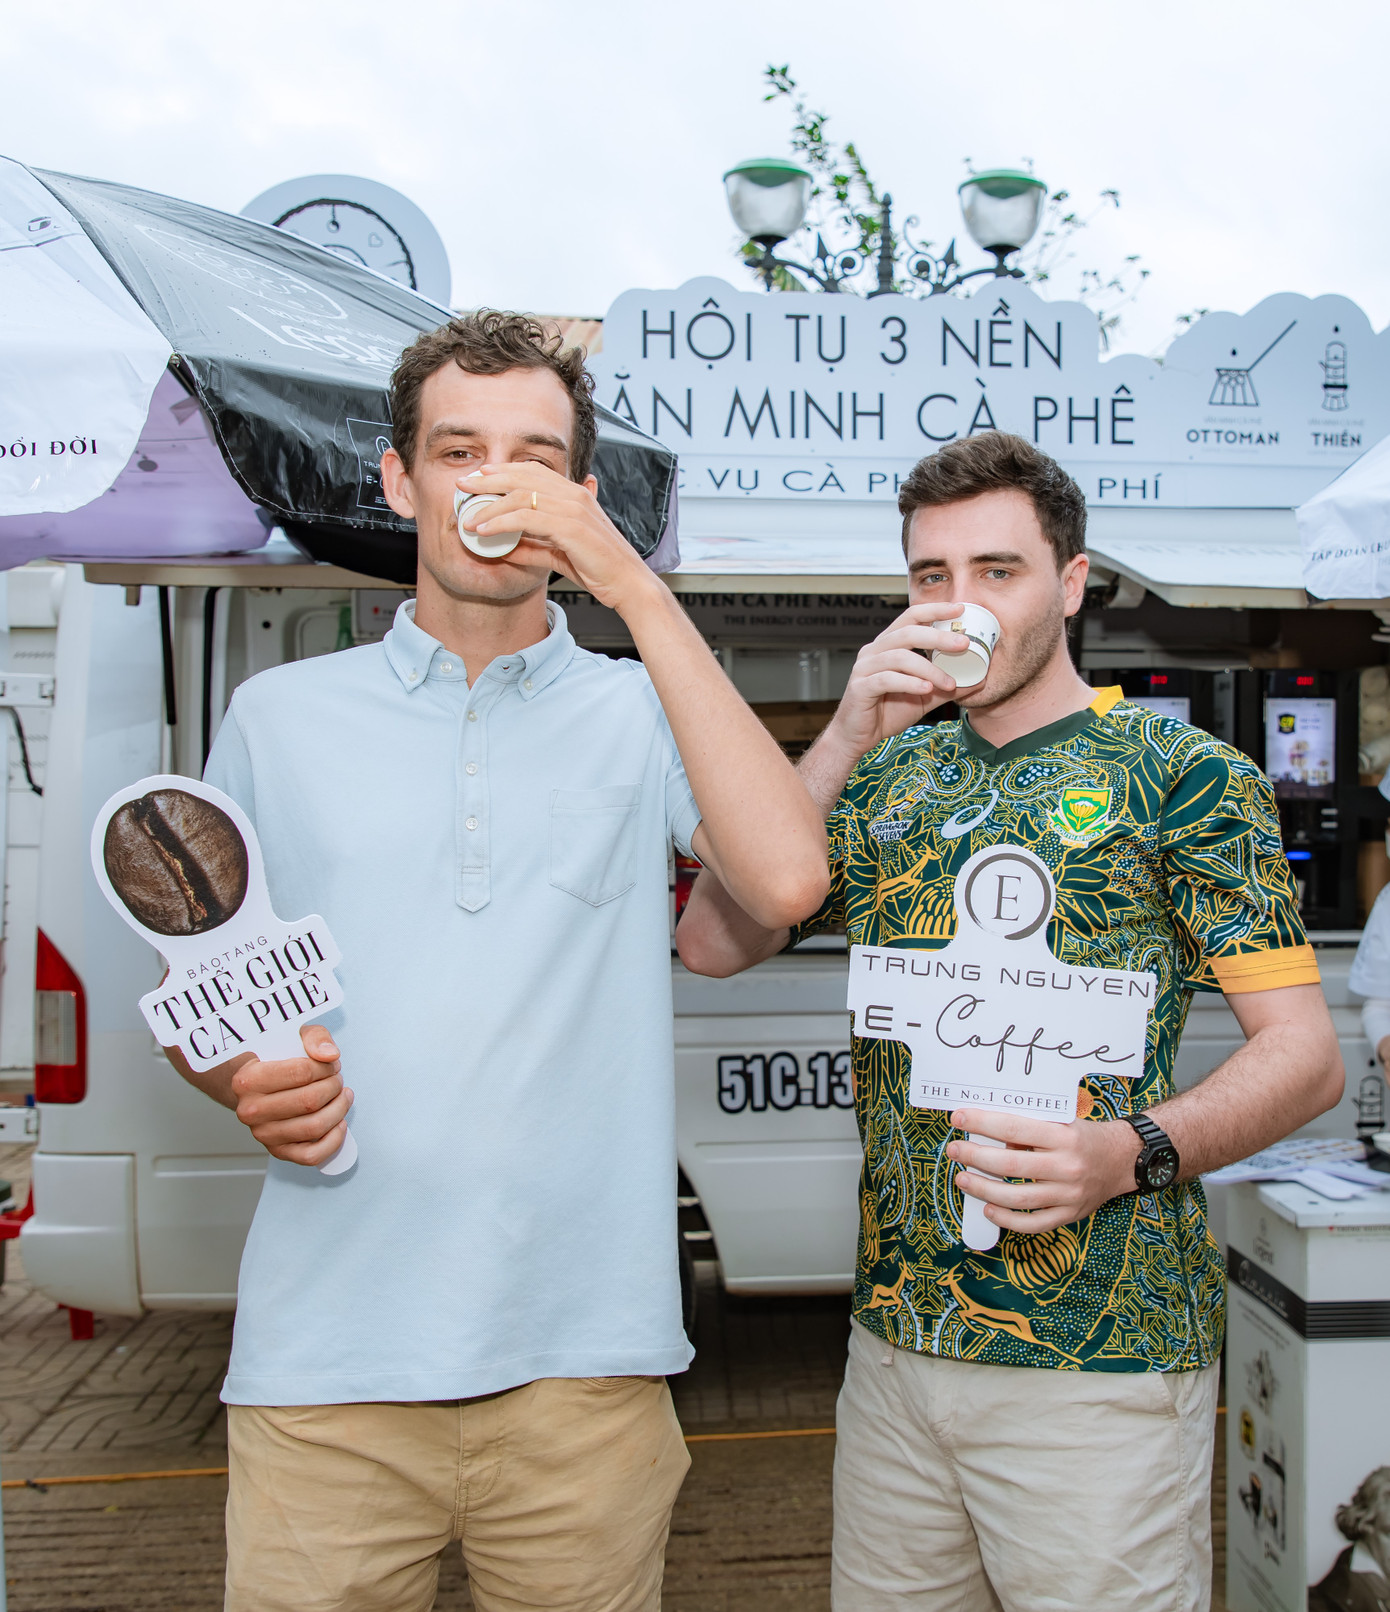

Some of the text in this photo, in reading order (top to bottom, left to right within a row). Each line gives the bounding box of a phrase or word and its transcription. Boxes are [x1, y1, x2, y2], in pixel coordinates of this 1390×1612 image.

[642, 297, 1062, 373] HỘI TỤ 3 NỀN
[613, 373, 1134, 445] ĂN MINH CÀ PHÊ
[48, 435, 98, 455] ĐỜI
[1186, 429, 1279, 445] OTTOMAN
[707, 468, 759, 495] VỤ
[782, 462, 845, 493] CÀ
[1099, 473, 1162, 499] PHÍ
[870, 821, 910, 834] SPRINGBOK
[879, 830, 901, 841] SEVENS
[1055, 824, 1100, 841] SOUTH AFRICA
[991, 873, 1022, 922] E
[153, 930, 327, 1032] THẾ GIỚI
[862, 954, 1150, 998] TRUNG NGUYEN
[189, 971, 329, 1060] CÀ PHÊ
[718, 1050, 854, 1114] 51C.13
[921, 1085, 1069, 1110] THE No.1 COFFEE!
